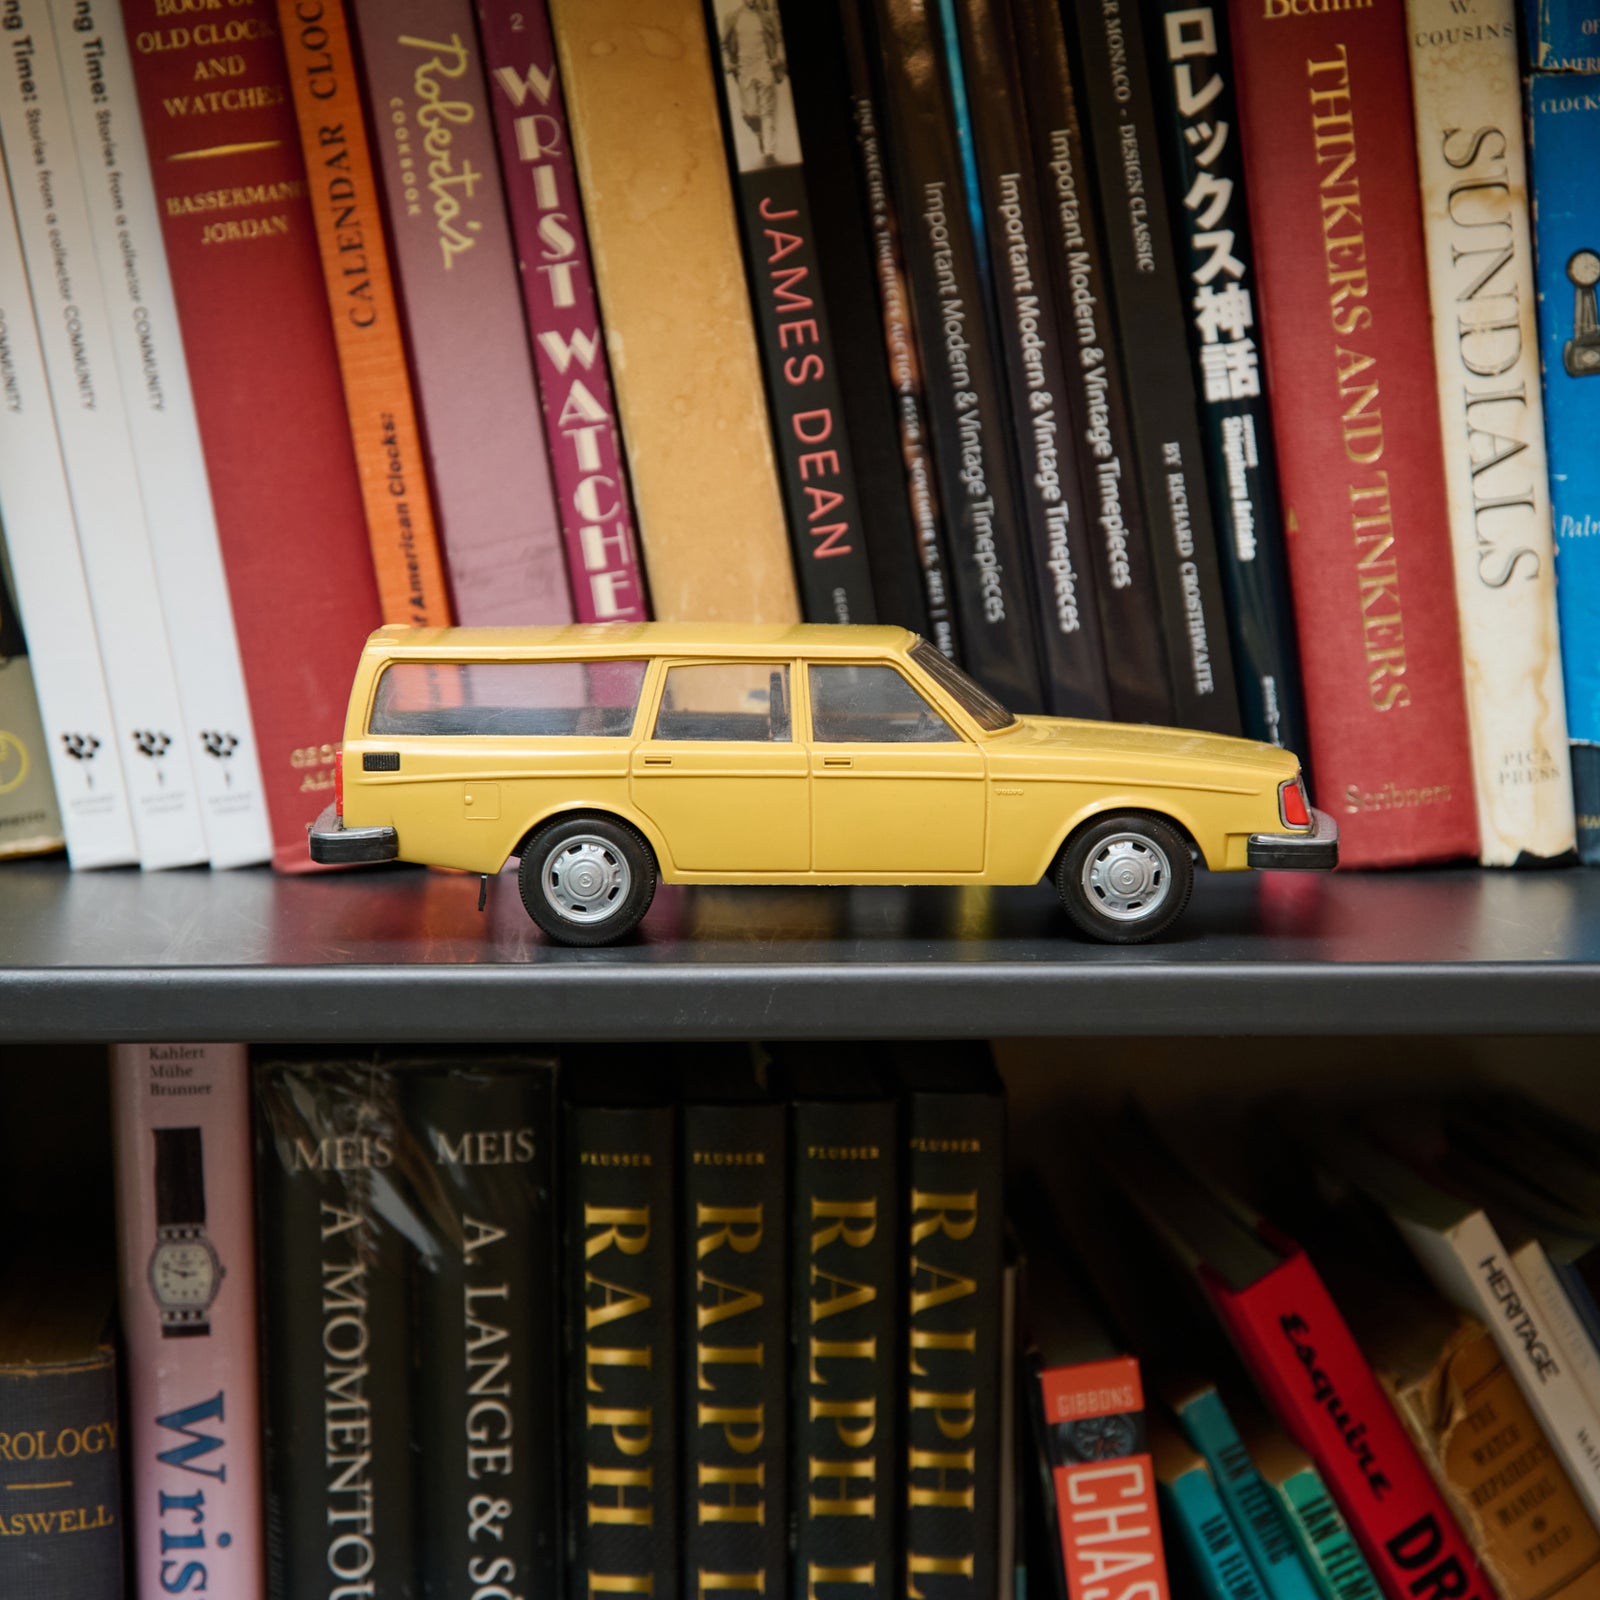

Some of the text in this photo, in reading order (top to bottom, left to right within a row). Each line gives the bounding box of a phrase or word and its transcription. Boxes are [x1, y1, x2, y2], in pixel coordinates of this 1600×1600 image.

[136, 27, 192, 54] OLD
[510, 13, 525, 31] 2
[1415, 22, 1514, 48] COUSINS
[13, 35, 37, 102] Time:
[83, 36, 108, 103] Time:
[193, 54, 247, 81] AND
[1105, 15, 1132, 102] MONACO
[25, 108, 46, 167] Stories
[858, 99, 875, 139] FINE
[1541, 94, 1600, 115] CLOCK
[95, 109, 115, 168] Stories
[390, 97, 421, 217] COOKBOOK
[398, 33, 484, 271] Roberta's
[1119, 124, 1145, 195] DESIGN
[41, 171, 53, 209] from
[110, 171, 125, 210] from
[865, 138, 886, 211] WATCHES
[1164, 7, 1260, 402] ロレックス神話
[1307, 44, 1372, 335] THINKERS
[46, 212, 57, 226] a
[116, 213, 127, 227] a
[201, 216, 289, 245] JORDAN
[318, 123, 378, 328] CALENDAR
[873, 214, 887, 229] &
[1129, 197, 1155, 274] CLASSIC
[877, 231, 902, 319] TIMEPIECES
[63, 304, 96, 412] COMMUNITY
[132, 306, 167, 413] COMMUNITY
[493, 62, 636, 622] WRIST WATCHE
[890, 321, 914, 393] AUCTION
[1050, 128, 1132, 590] Important Modern & Vintage Timepieces
[1442, 126, 1540, 590] SUNDIALS
[760, 197, 853, 560] JAMES DEAN
[924, 182, 1006, 625] Important Modern & Vintage Timepieces
[998, 173, 1081, 634] Important Modern & Vintage Timepieces
[1336, 344, 1384, 464] AND
[381, 411, 408, 497] Clocks:
[911, 457, 937, 543] NOVEMBER
[397, 501, 427, 609] American
[1163, 441, 1214, 697] BY RICHARD CROSTHWAITE
[1349, 470, 1412, 713] TINKERS
[290, 742, 342, 769] GEO
[1499, 768, 1561, 786] PRESS
[1504, 751, 1554, 766] PICA
[149, 1046, 205, 1061] Kahlert
[150, 1064, 193, 1079] Mühe
[150, 1082, 212, 1097] Brunner
[294, 1136, 395, 1172] MEIS
[437, 1128, 536, 1166] MEIS
[581, 1152, 653, 1167] FLUSSER
[694, 1152, 766, 1166] FLUSSER
[808, 1145, 880, 1161] FLUSSER
[910, 1137, 981, 1153] FLUSSER
[321, 1203, 364, 1241] A
[463, 1213, 508, 1265] A.
[908, 1187, 979, 1513] RALPH
[1480, 1256, 1561, 1386] HERITAGE
[464, 1284, 515, 1480] LANGE
[584, 1202, 654, 1527] RALPH
[697, 1202, 766, 1526] RALPH
[809, 1195, 878, 1520] RALPH
[1056, 1385, 1135, 1418] GIBBONS
[1279, 1311, 1393, 1502] Esquire
[1472, 1422, 1522, 1467] WATCH
[467, 1493, 513, 1543] &
[1199, 1514, 1232, 1552] IAN
[1216, 1441, 1298, 1566] IAN FLEMING
[1299, 1495, 1342, 1545] IAN
[1498, 1476, 1558, 1527] MANUAL
